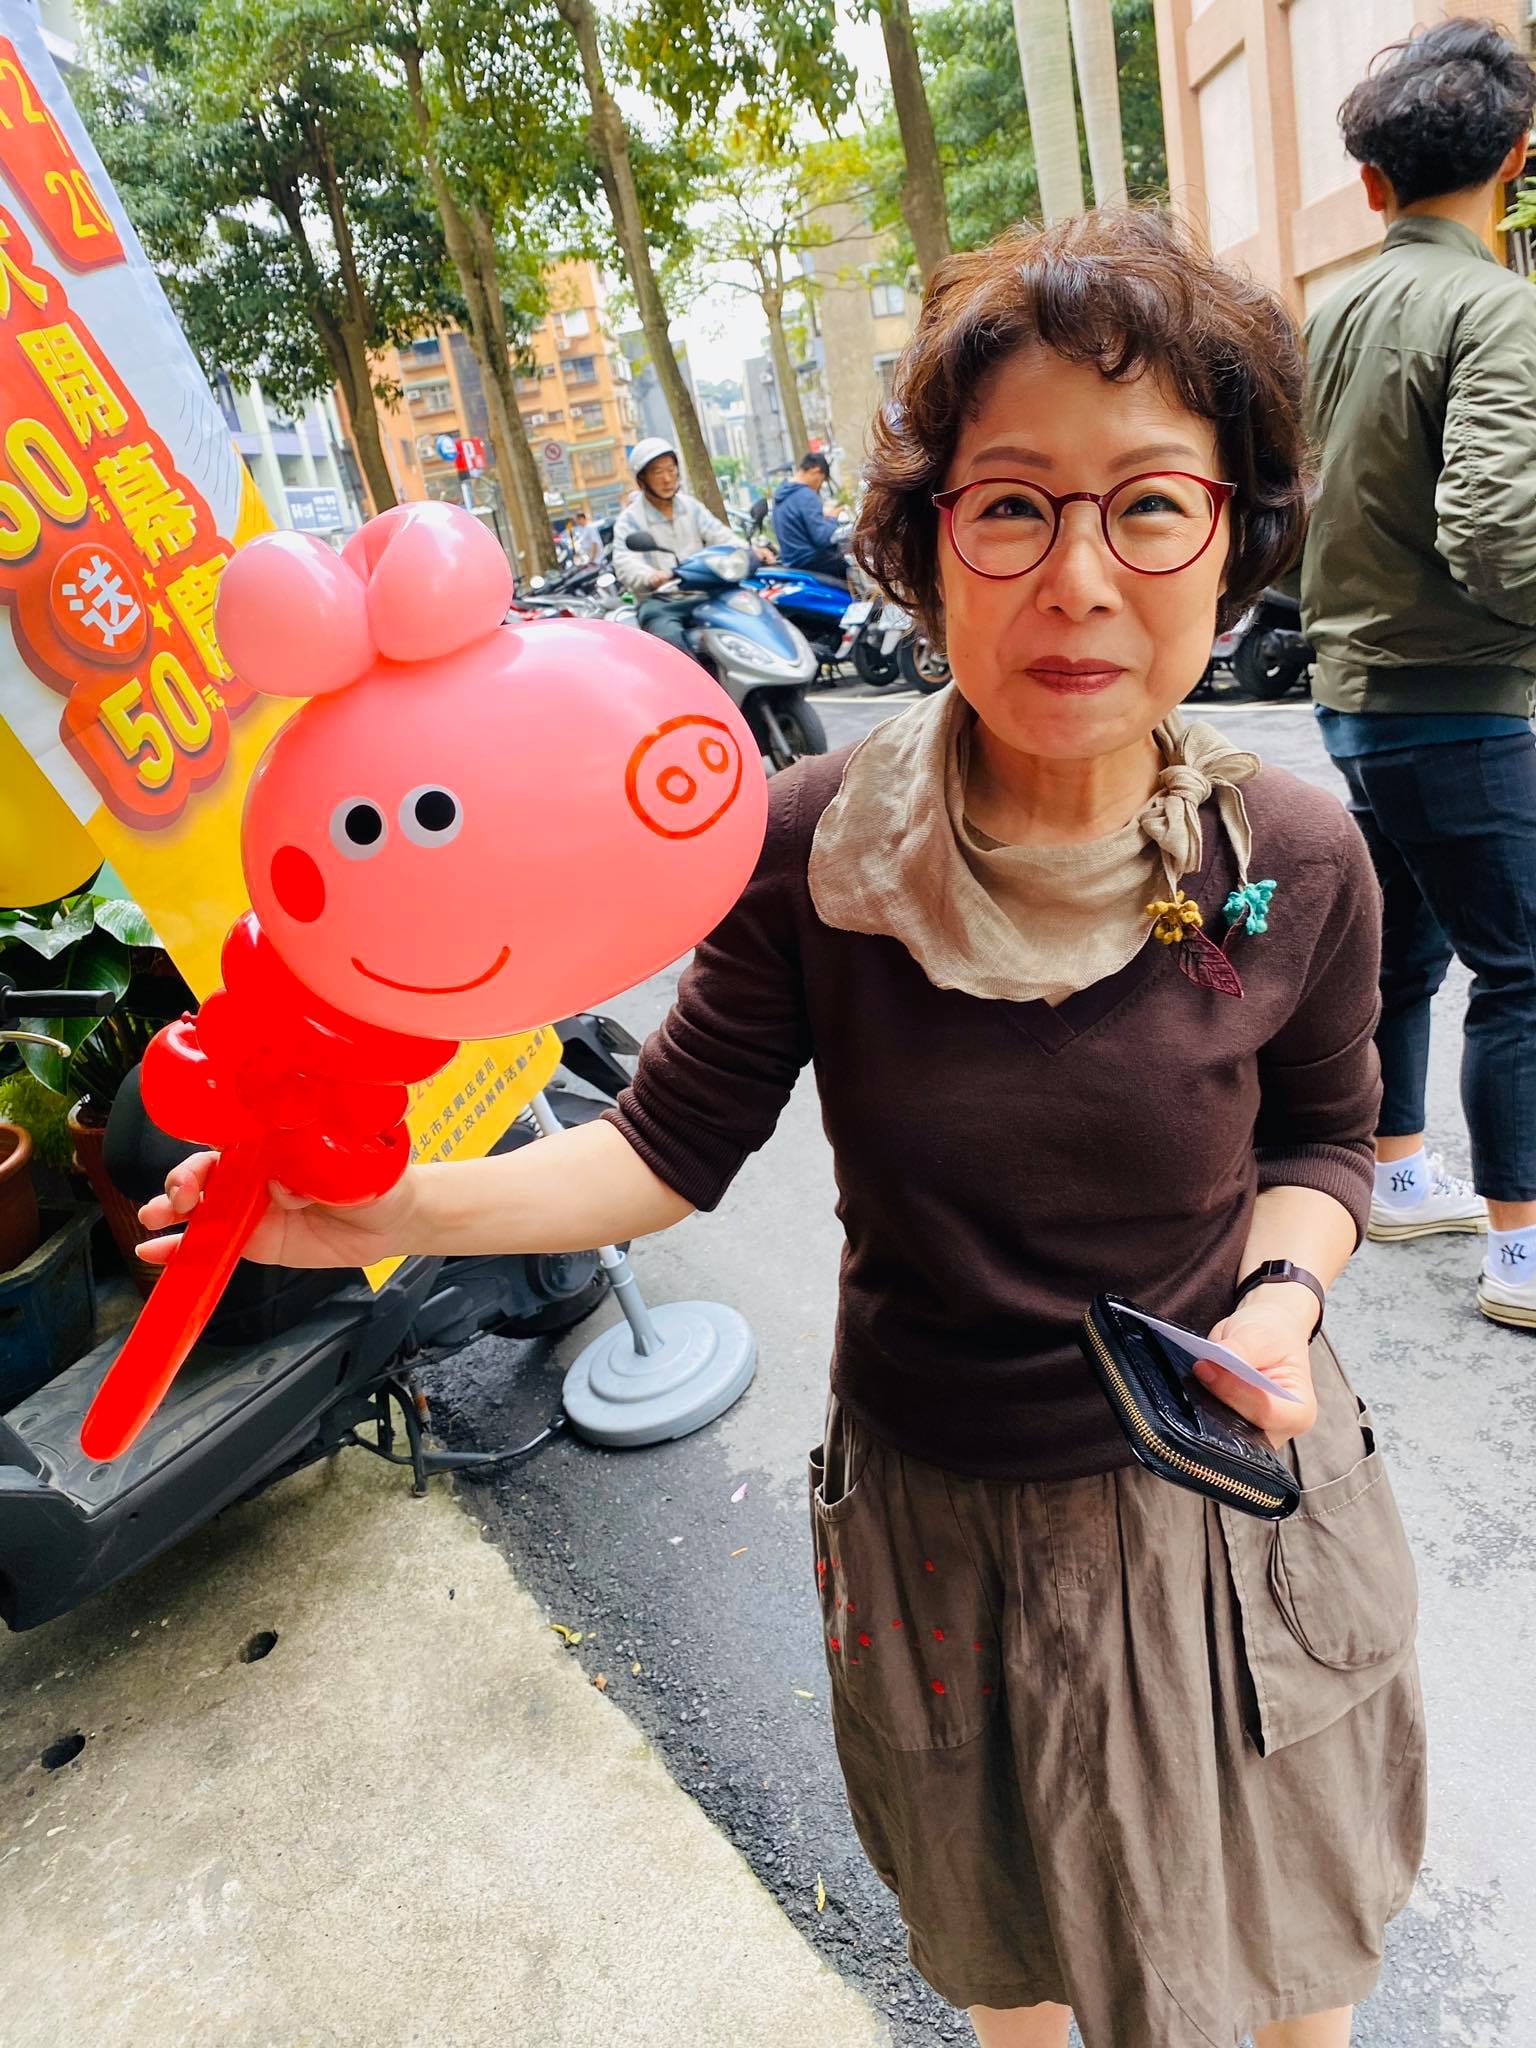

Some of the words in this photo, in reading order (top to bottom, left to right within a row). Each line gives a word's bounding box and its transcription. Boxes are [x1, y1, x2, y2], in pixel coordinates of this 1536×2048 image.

[44, 168, 114, 239] 20
[62, 555, 141, 647] 送
[1391, 1169, 1415, 1192] NY
[1500, 1242, 1527, 1265] NY
